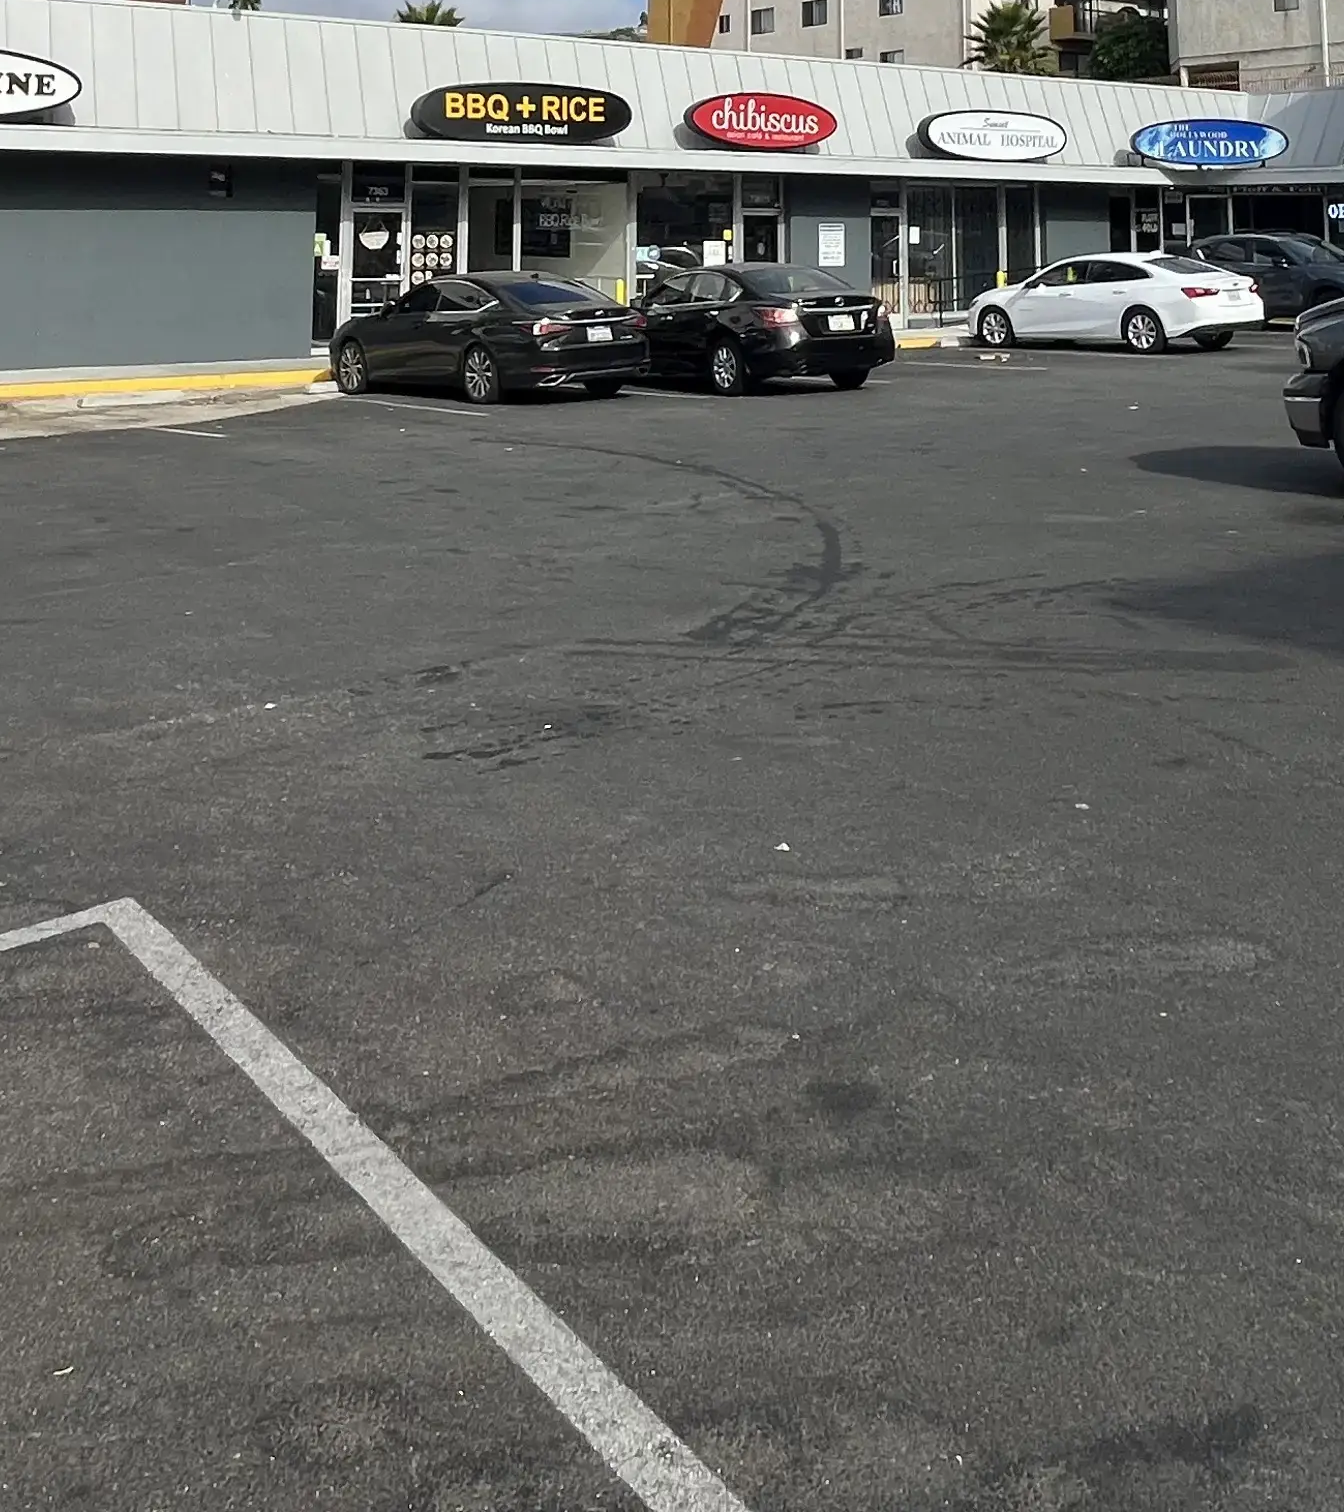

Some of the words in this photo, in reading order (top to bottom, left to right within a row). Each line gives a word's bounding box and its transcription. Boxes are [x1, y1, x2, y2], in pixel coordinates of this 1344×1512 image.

[445, 92, 510, 121] BBQ
[516, 96, 537, 119] +
[542, 95, 605, 122] RICE
[711, 97, 820, 135] chibiscus
[486, 123, 521, 135] Korean
[522, 124, 544, 135] BBQ
[545, 124, 569, 135] Bowl
[937, 131, 992, 147] ANIMAL
[1000, 133, 1058, 149] HOSPITAL
[1157, 140, 1261, 158] LAUNDRY
